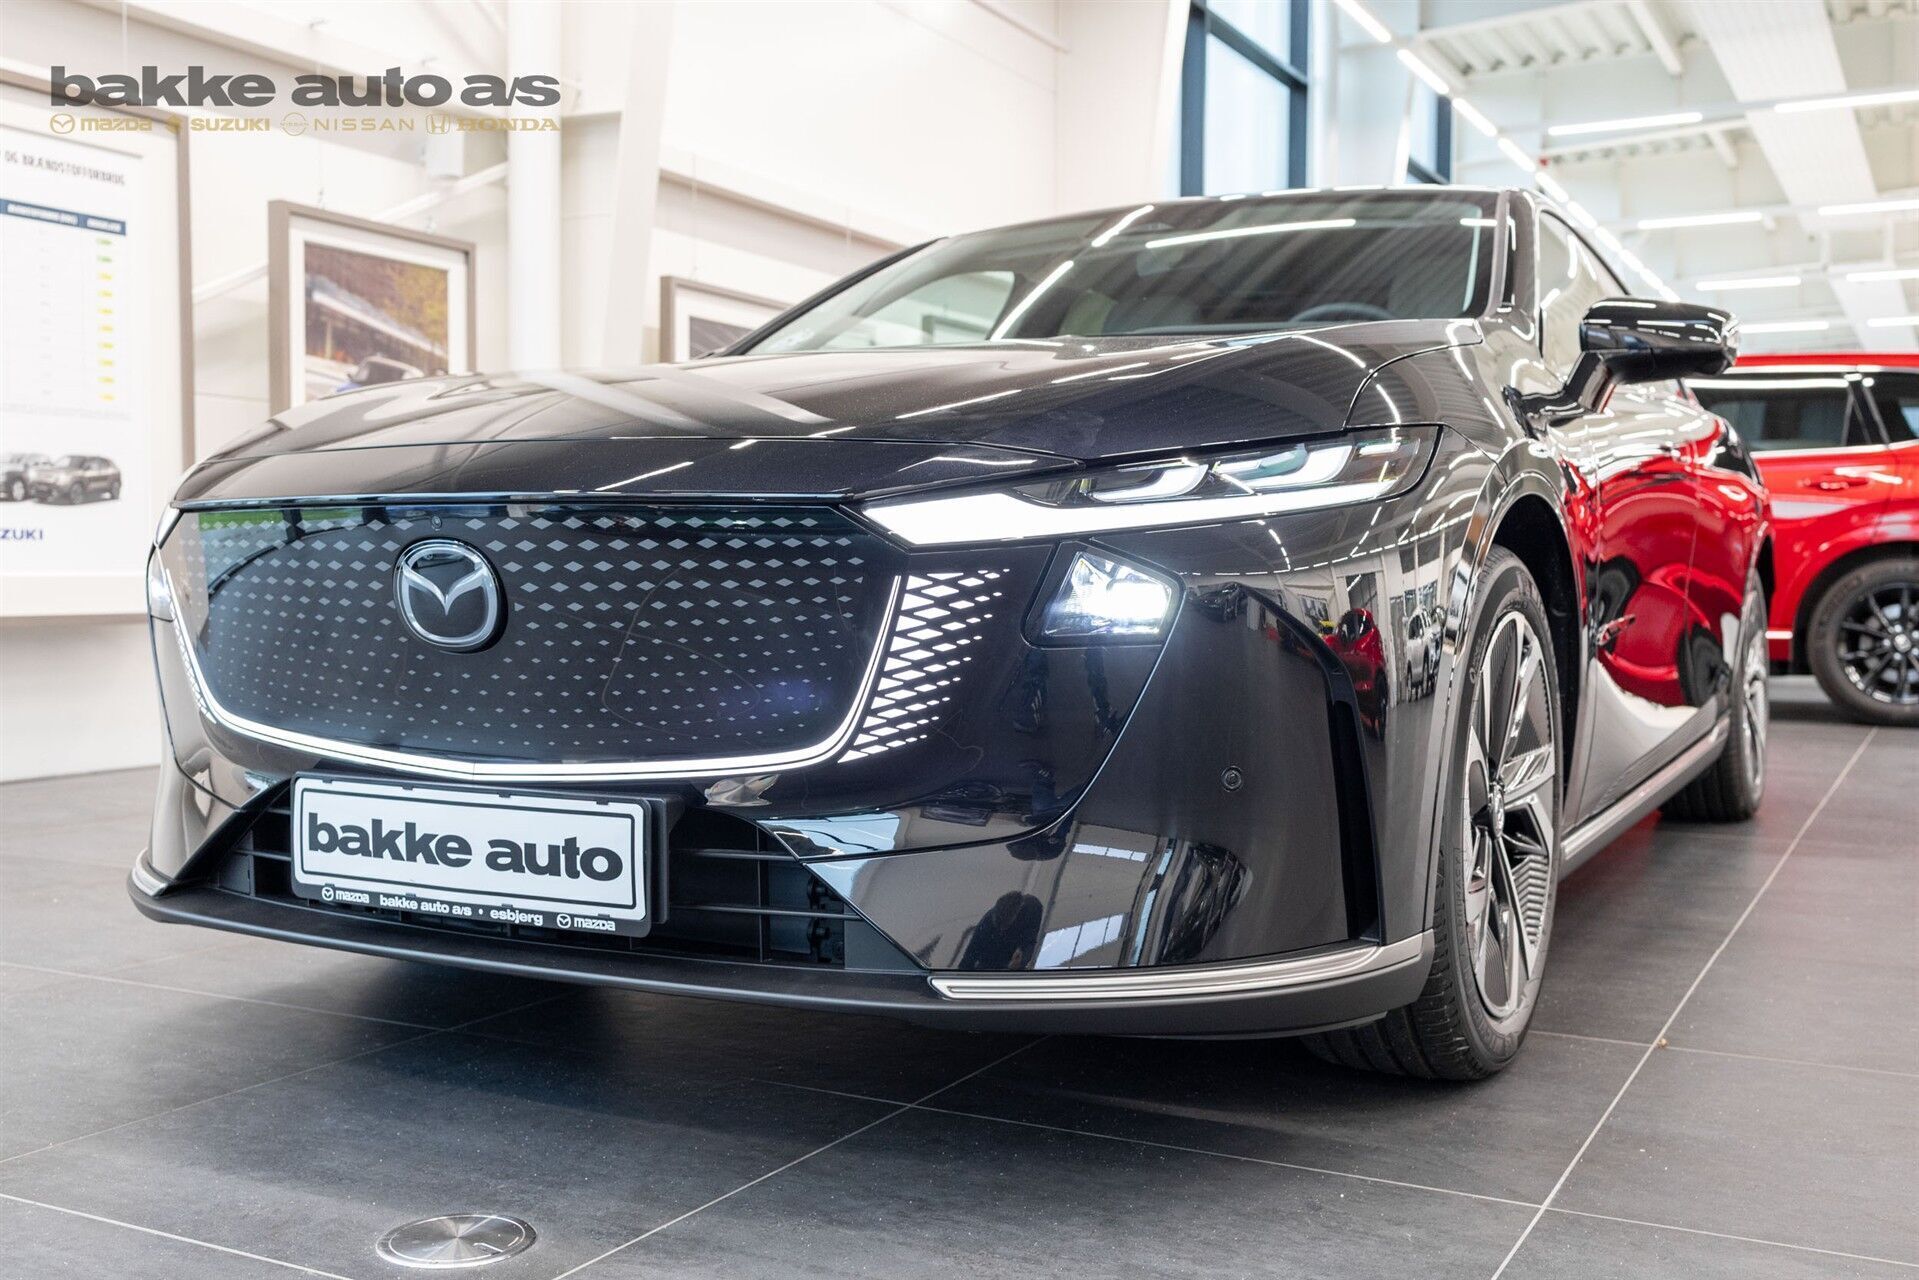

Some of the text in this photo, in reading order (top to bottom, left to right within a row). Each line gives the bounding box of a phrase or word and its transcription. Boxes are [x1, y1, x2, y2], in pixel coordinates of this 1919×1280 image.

[0, 528, 43, 541] ZUKI
[308, 812, 623, 882] bakke auto
[335, 889, 616, 932] mazda bakke auto a/s esbjerg mazda
